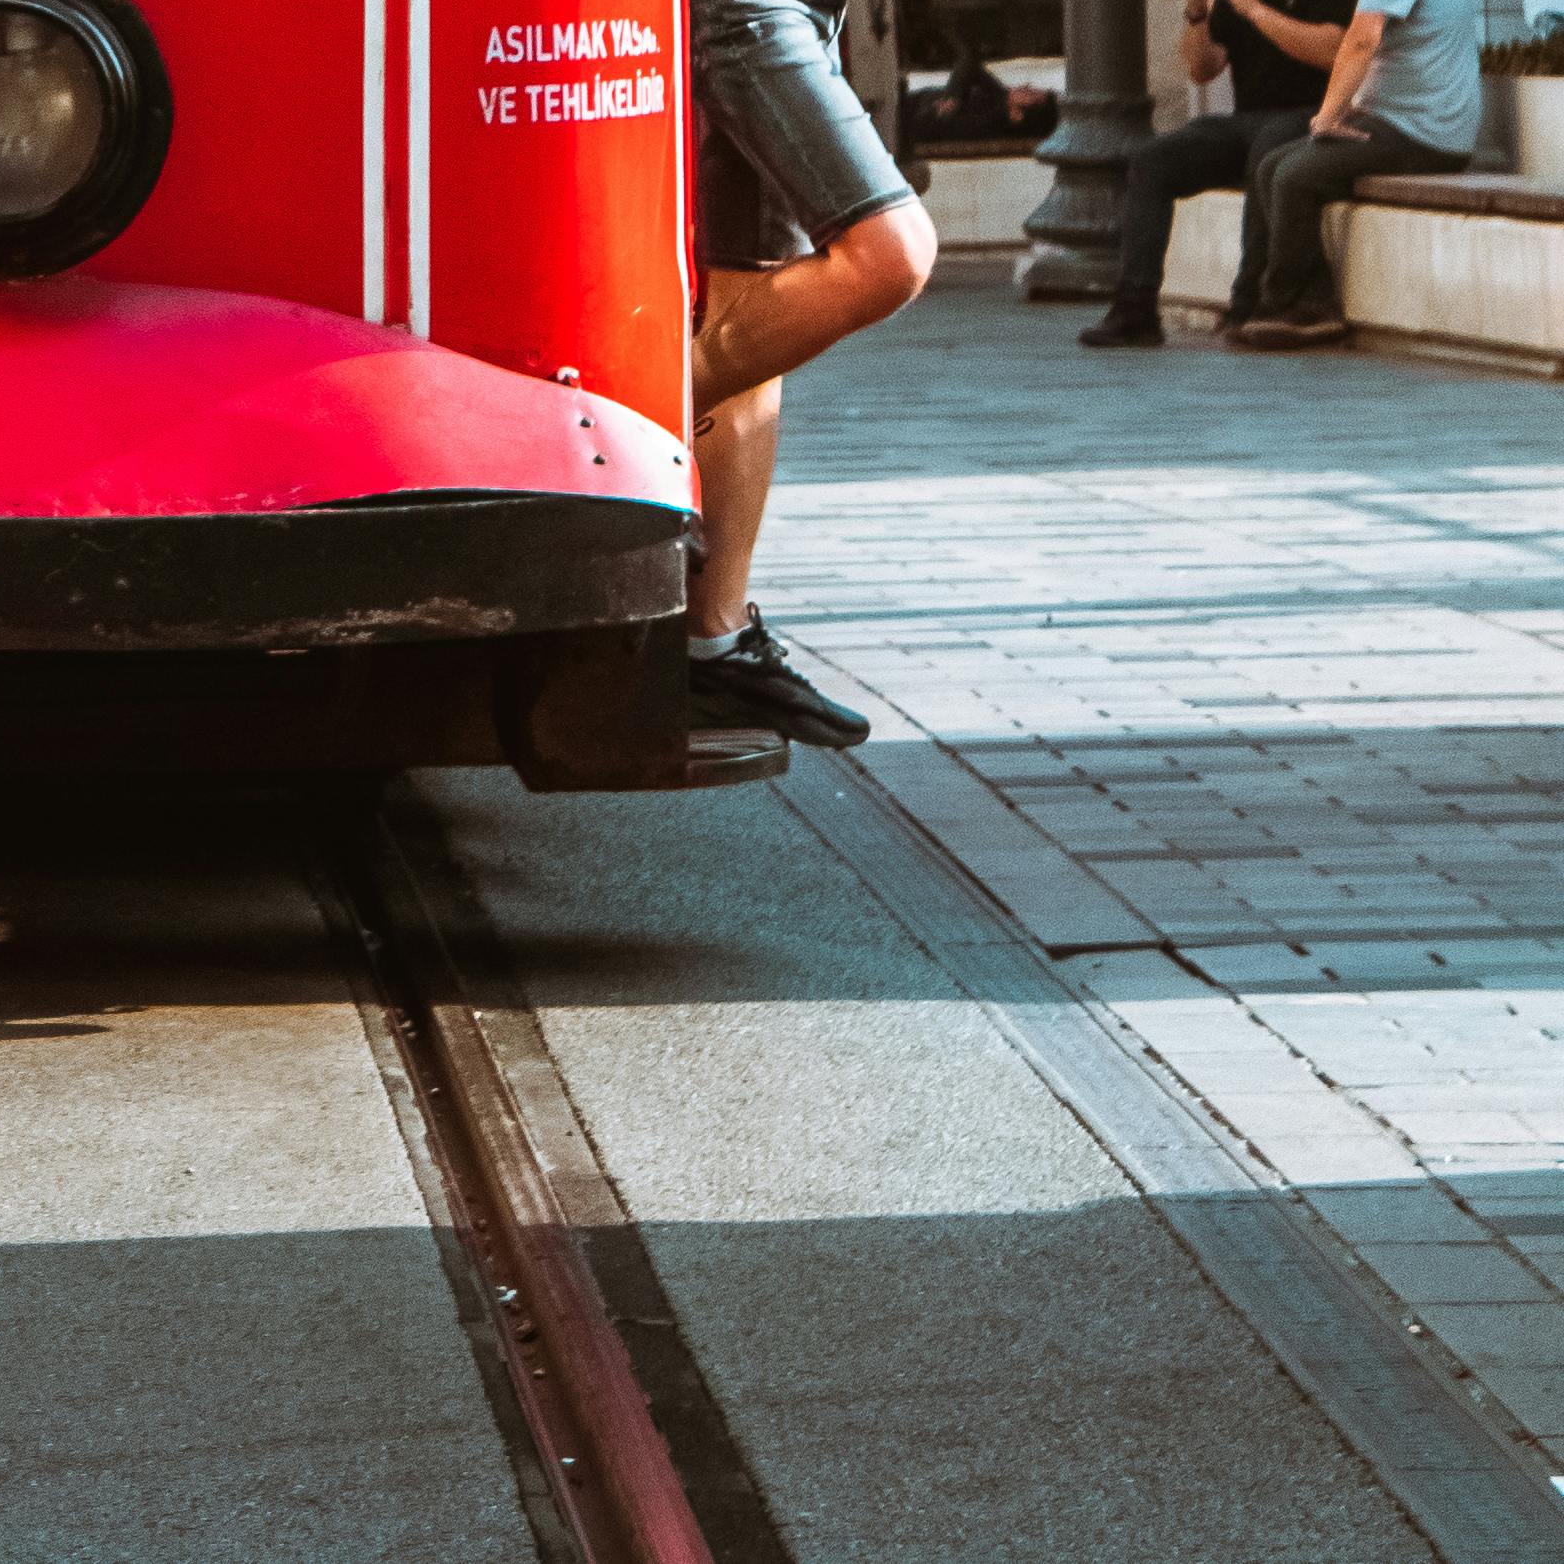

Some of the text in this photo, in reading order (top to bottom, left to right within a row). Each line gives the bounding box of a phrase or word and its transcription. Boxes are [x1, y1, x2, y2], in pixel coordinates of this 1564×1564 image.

[485, 20, 608, 65] ASILMAK
[477, 66, 665, 125] VE TEHLİKELİDİR
